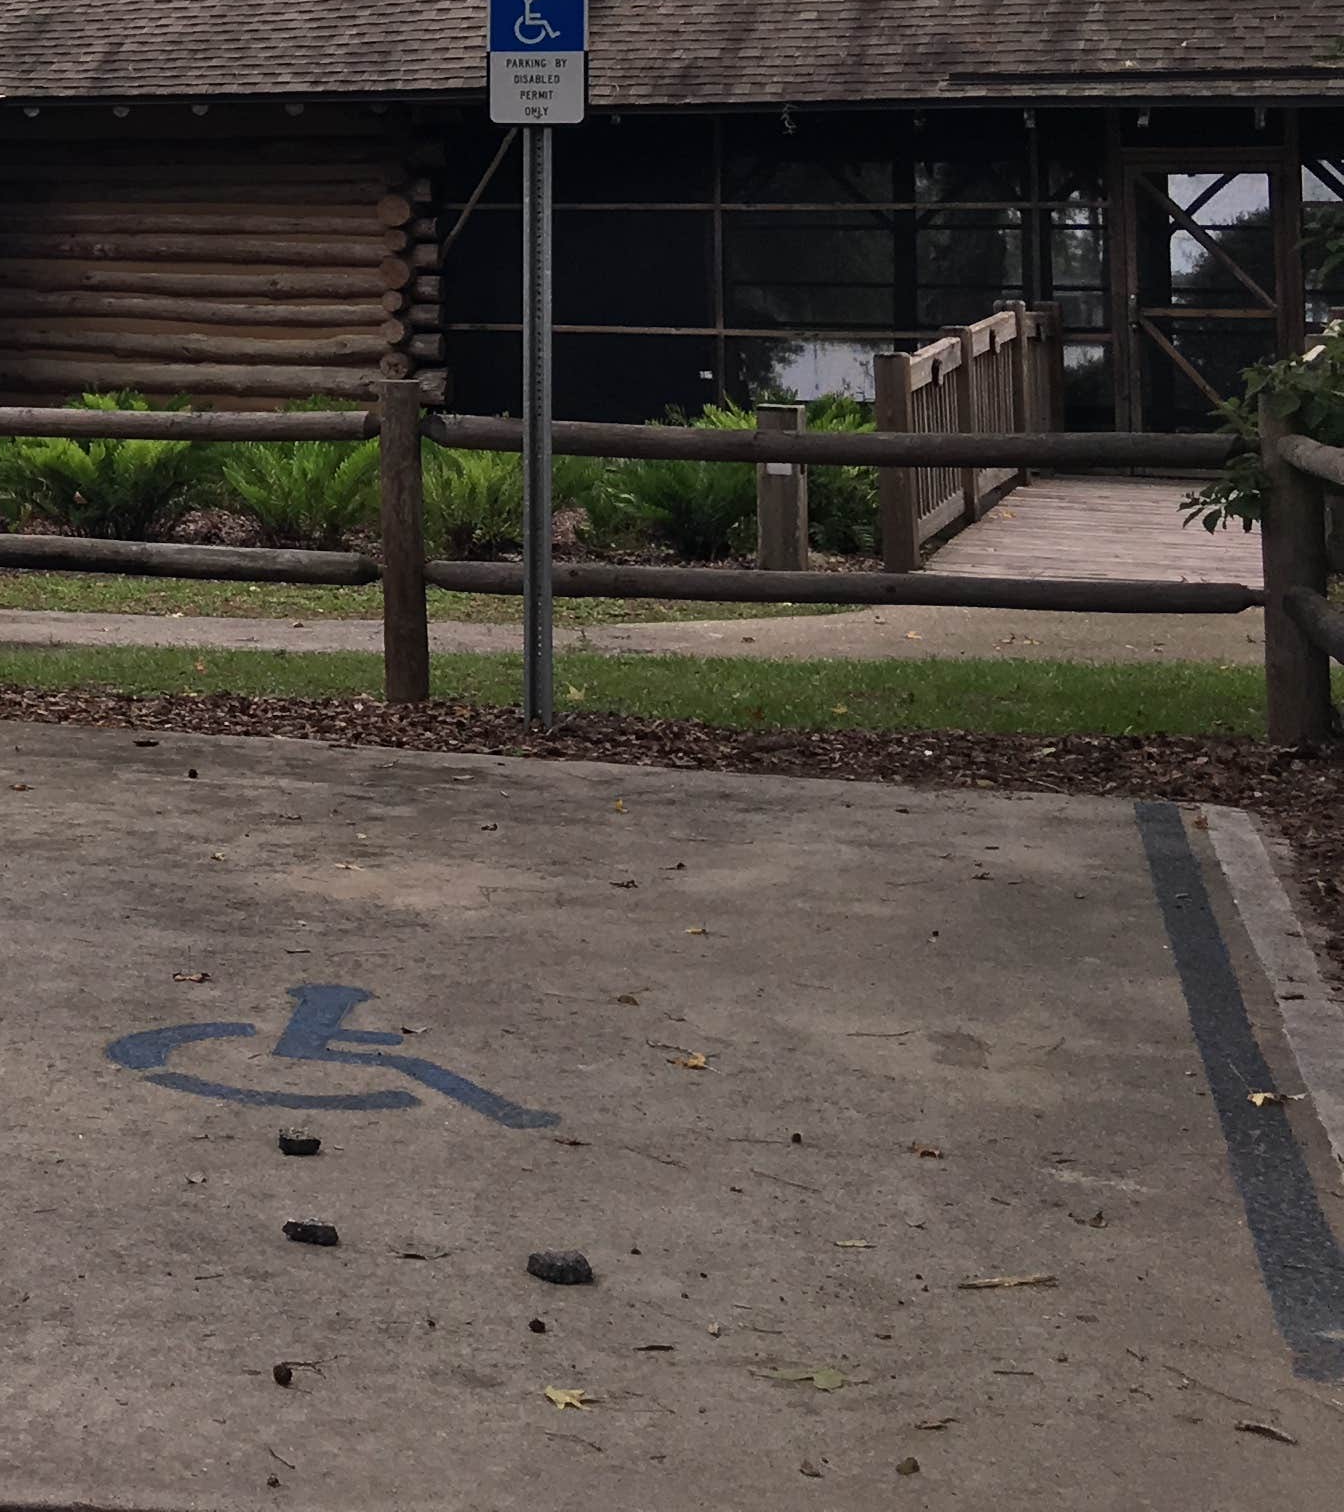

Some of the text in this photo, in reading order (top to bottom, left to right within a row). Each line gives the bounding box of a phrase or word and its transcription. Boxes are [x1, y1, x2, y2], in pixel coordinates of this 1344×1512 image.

[505, 58, 568, 68] PARKING BY
[513, 74, 561, 84] DISABLED
[520, 90, 554, 100] PERMIT
[524, 106, 549, 116] ONLY
